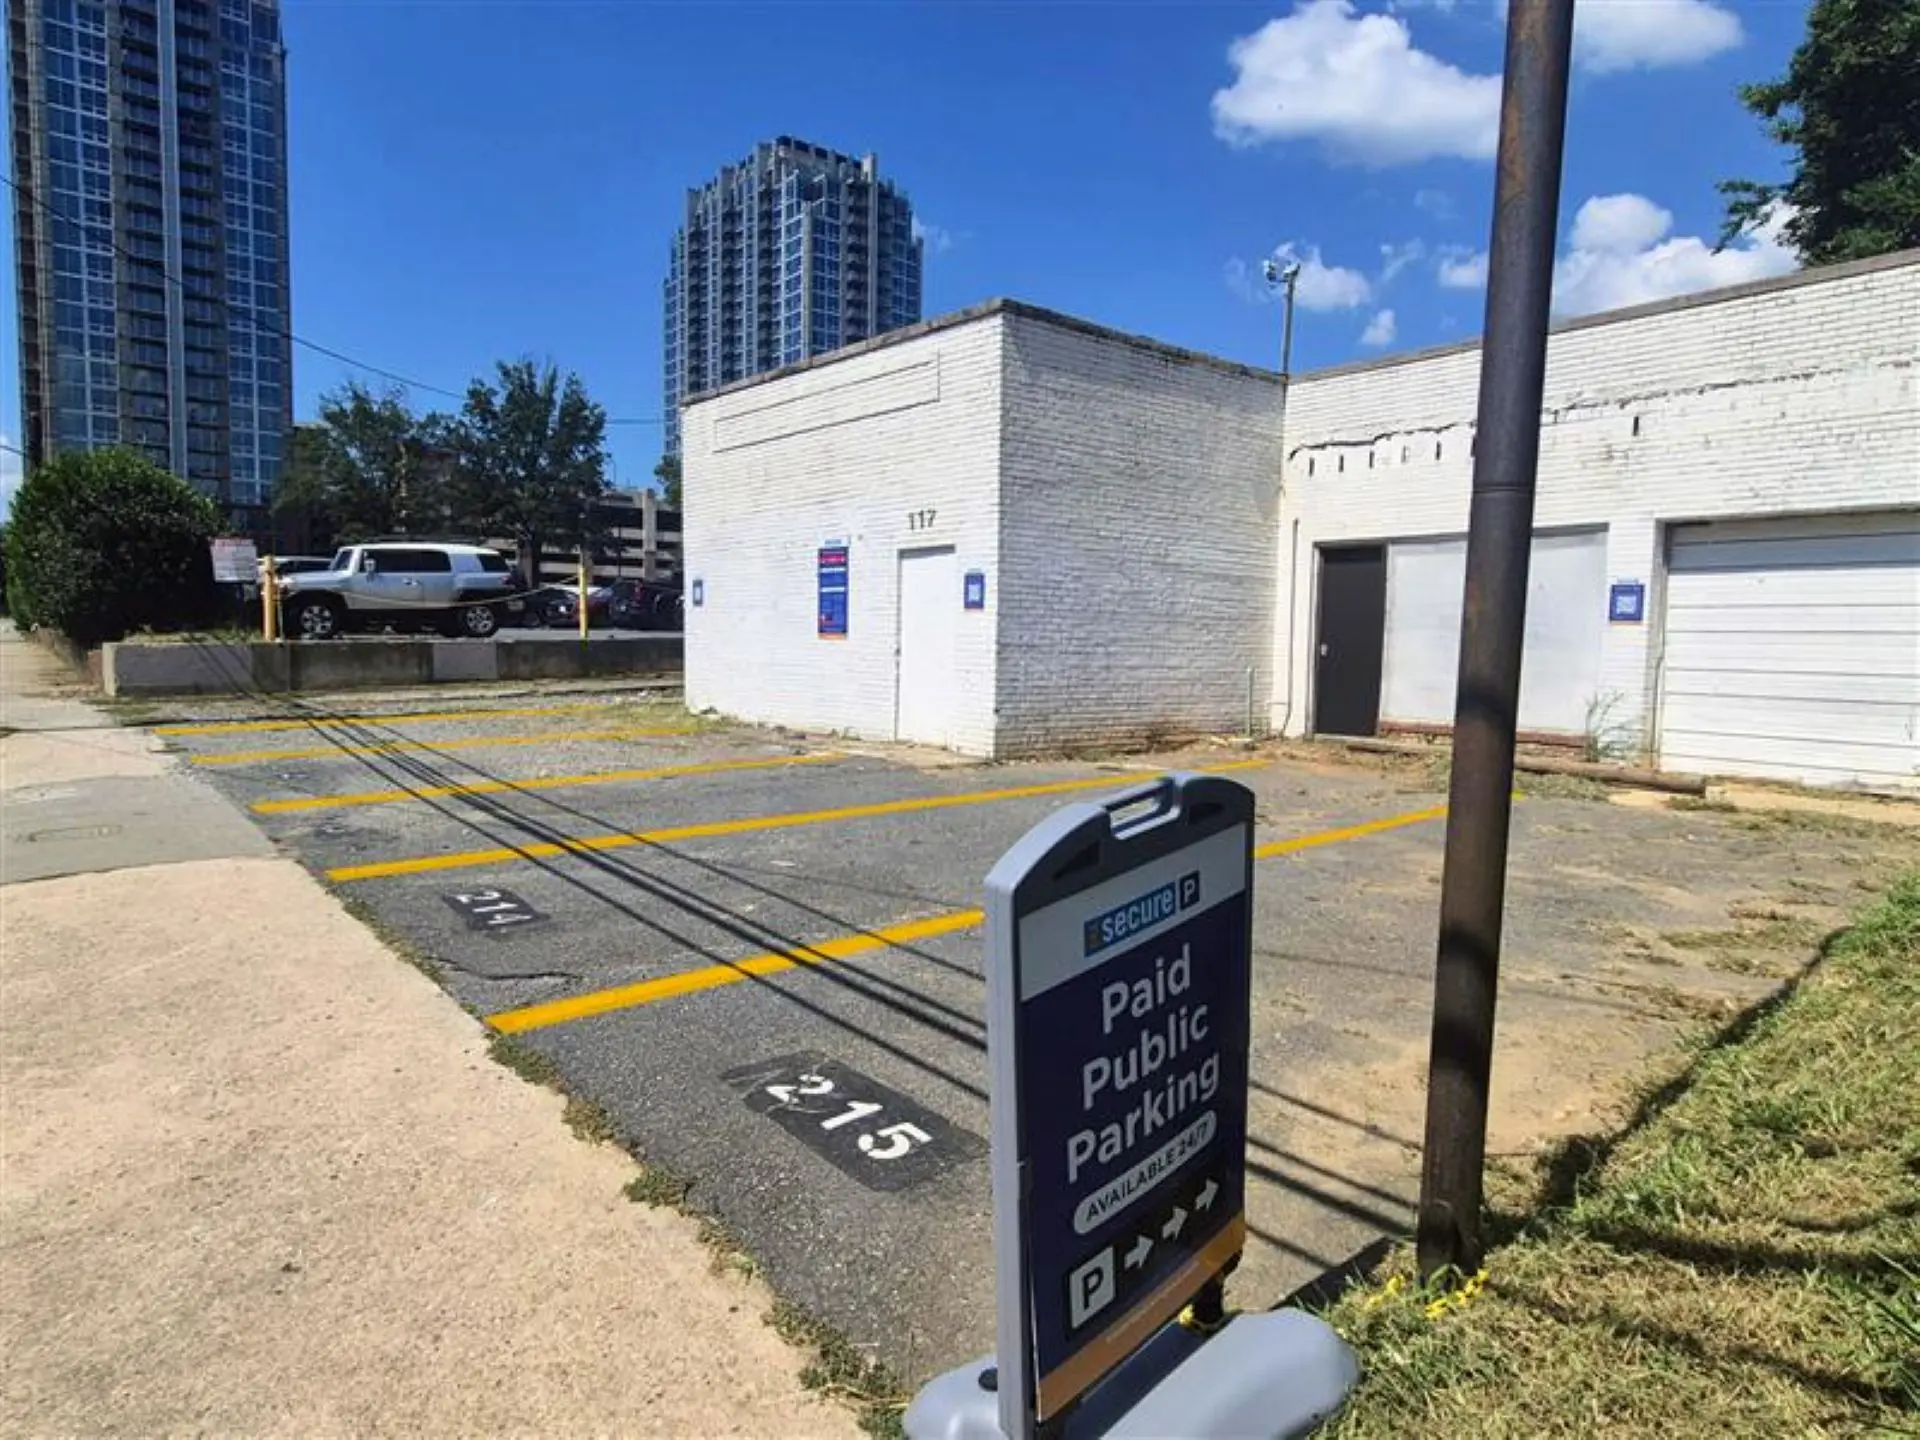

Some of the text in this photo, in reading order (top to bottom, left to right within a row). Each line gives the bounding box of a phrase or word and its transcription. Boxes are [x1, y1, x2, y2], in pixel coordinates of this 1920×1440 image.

[907, 509, 938, 530] 117
[1101, 888, 1174, 943] secure
[1101, 942, 1191, 1034] Paid
[1081, 1004, 1209, 1110] Public
[765, 1073, 934, 1161] 215
[1066, 1053, 1220, 1185] Parking
[1085, 1146, 1176, 1222] AVAILABLE
[1081, 1266, 1103, 1310] P
